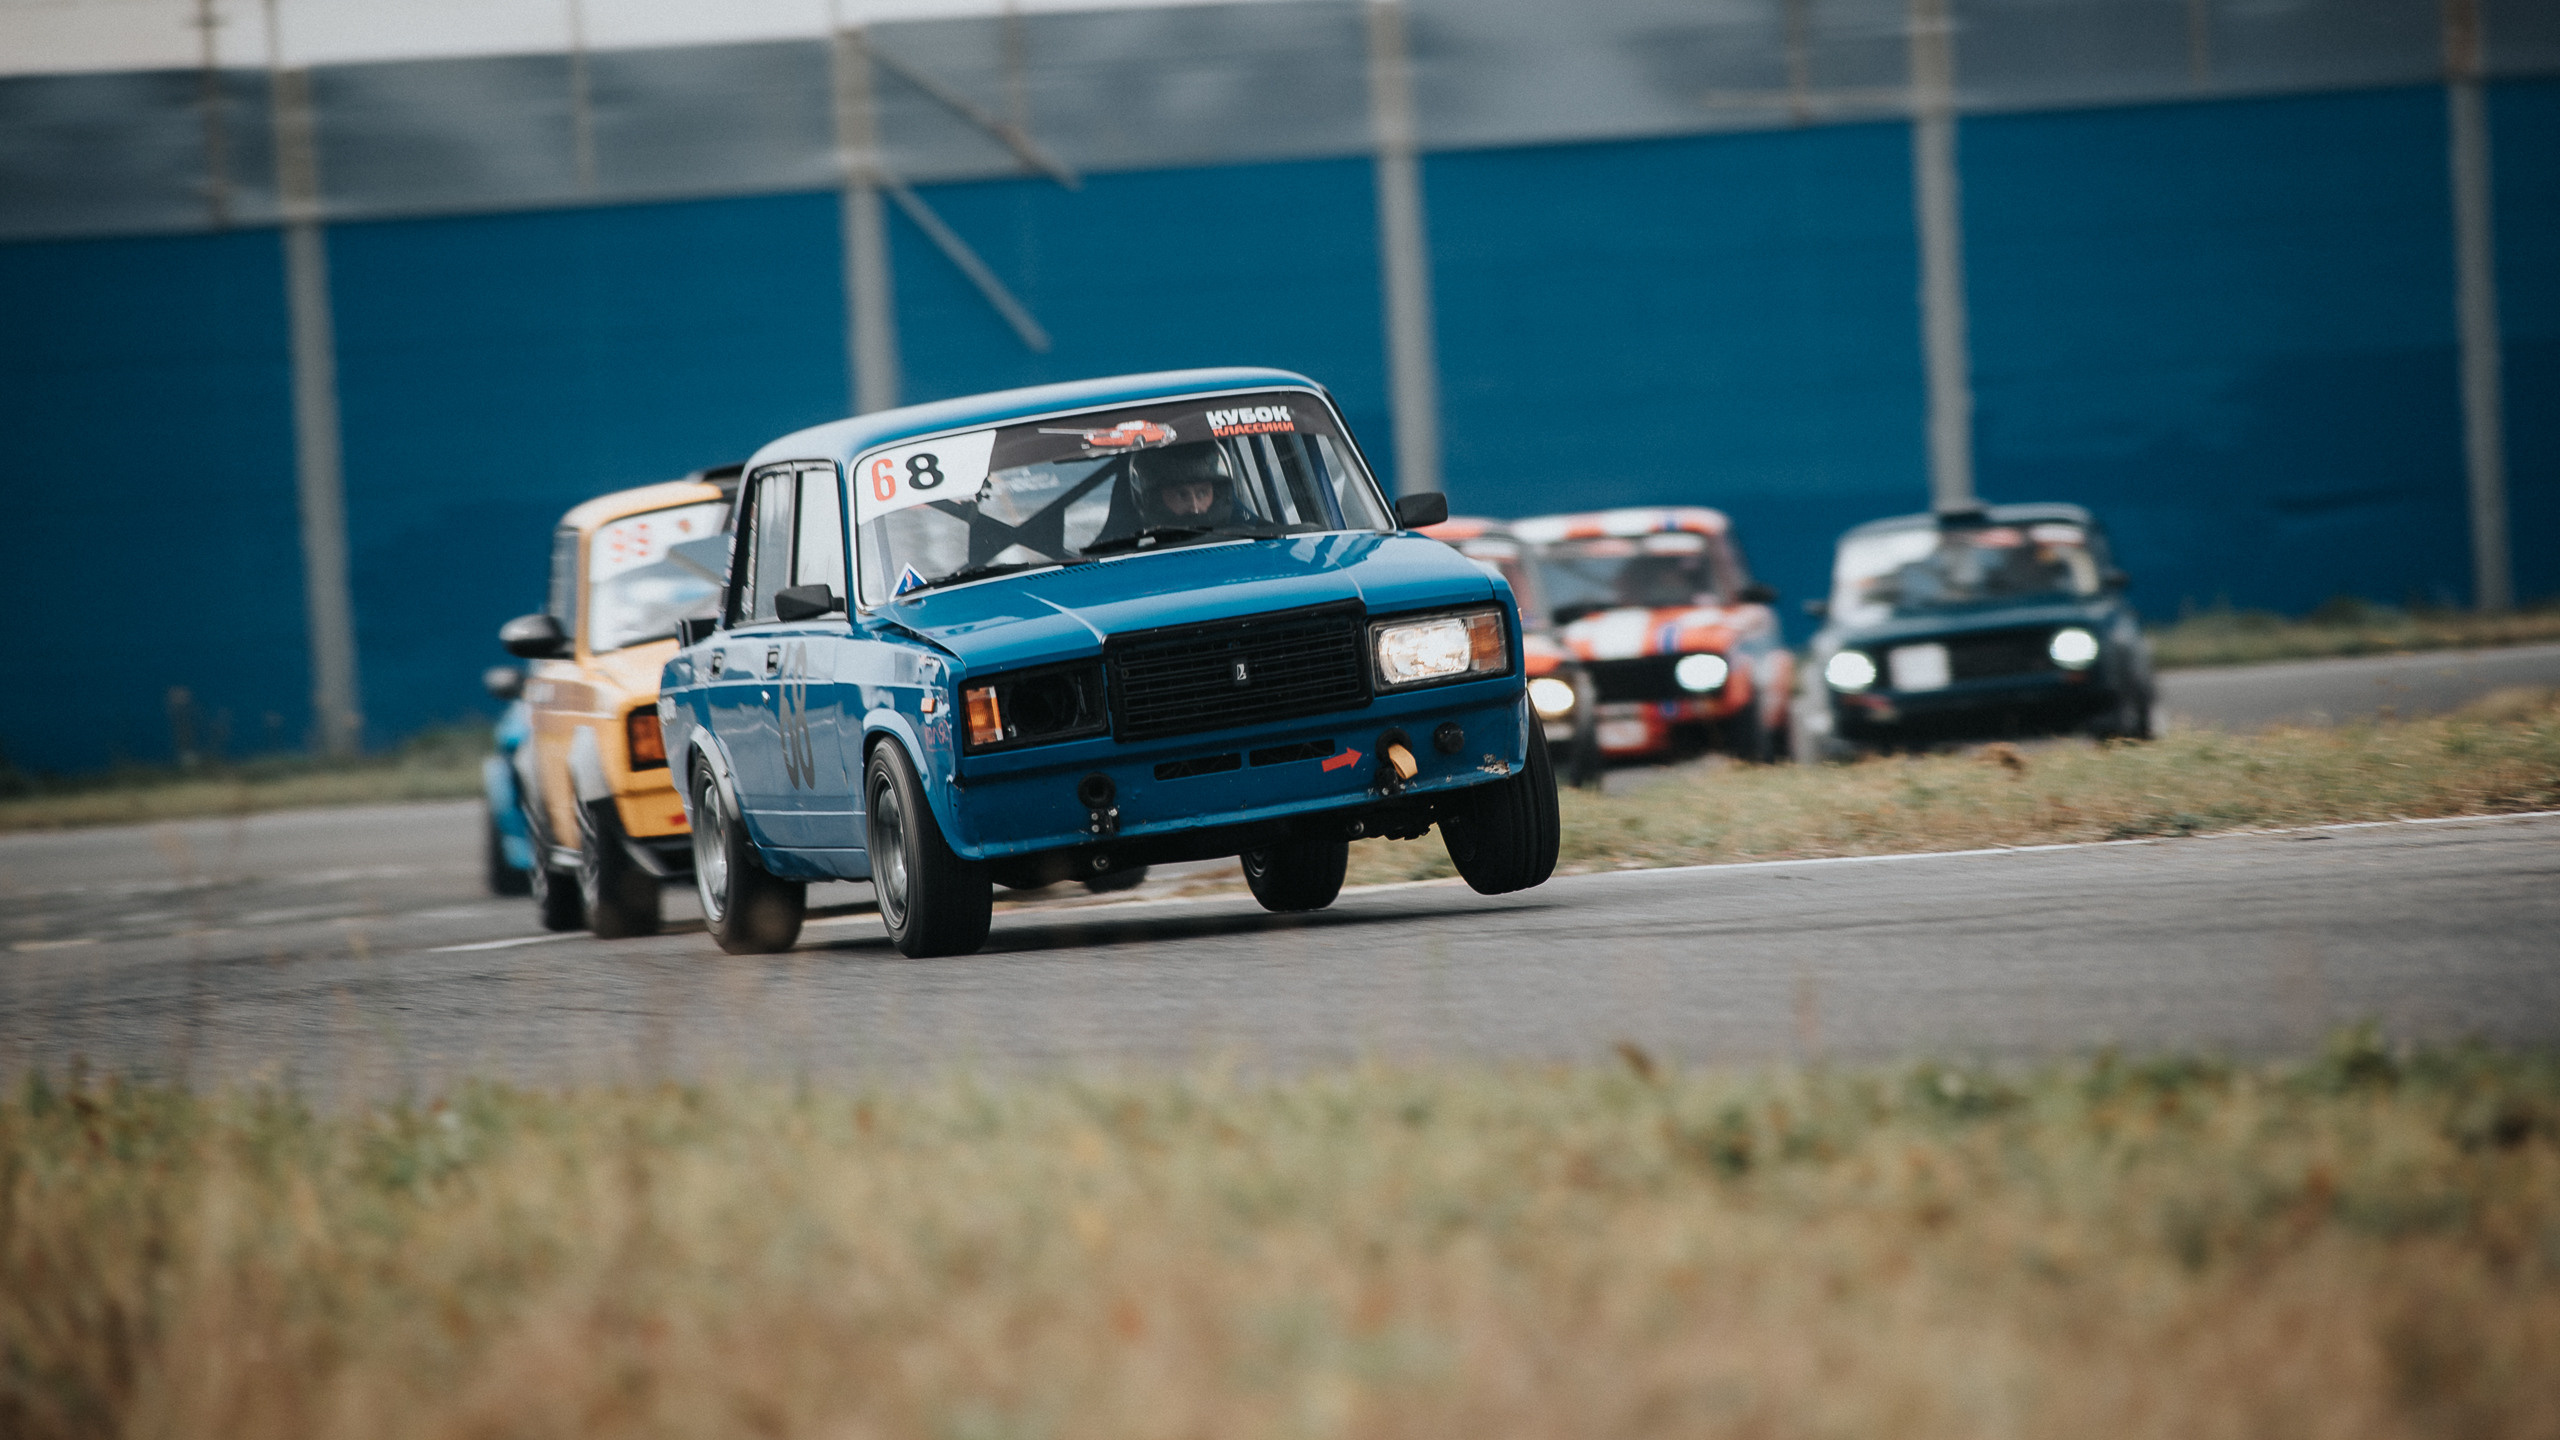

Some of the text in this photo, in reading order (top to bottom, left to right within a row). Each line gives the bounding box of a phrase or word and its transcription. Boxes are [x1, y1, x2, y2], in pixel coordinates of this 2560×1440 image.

[1206, 405, 1291, 430] КУБОК
[1212, 421, 1295, 437] КЛАССИКИ
[871, 453, 945, 502] 68
[778, 640, 816, 791] 68
